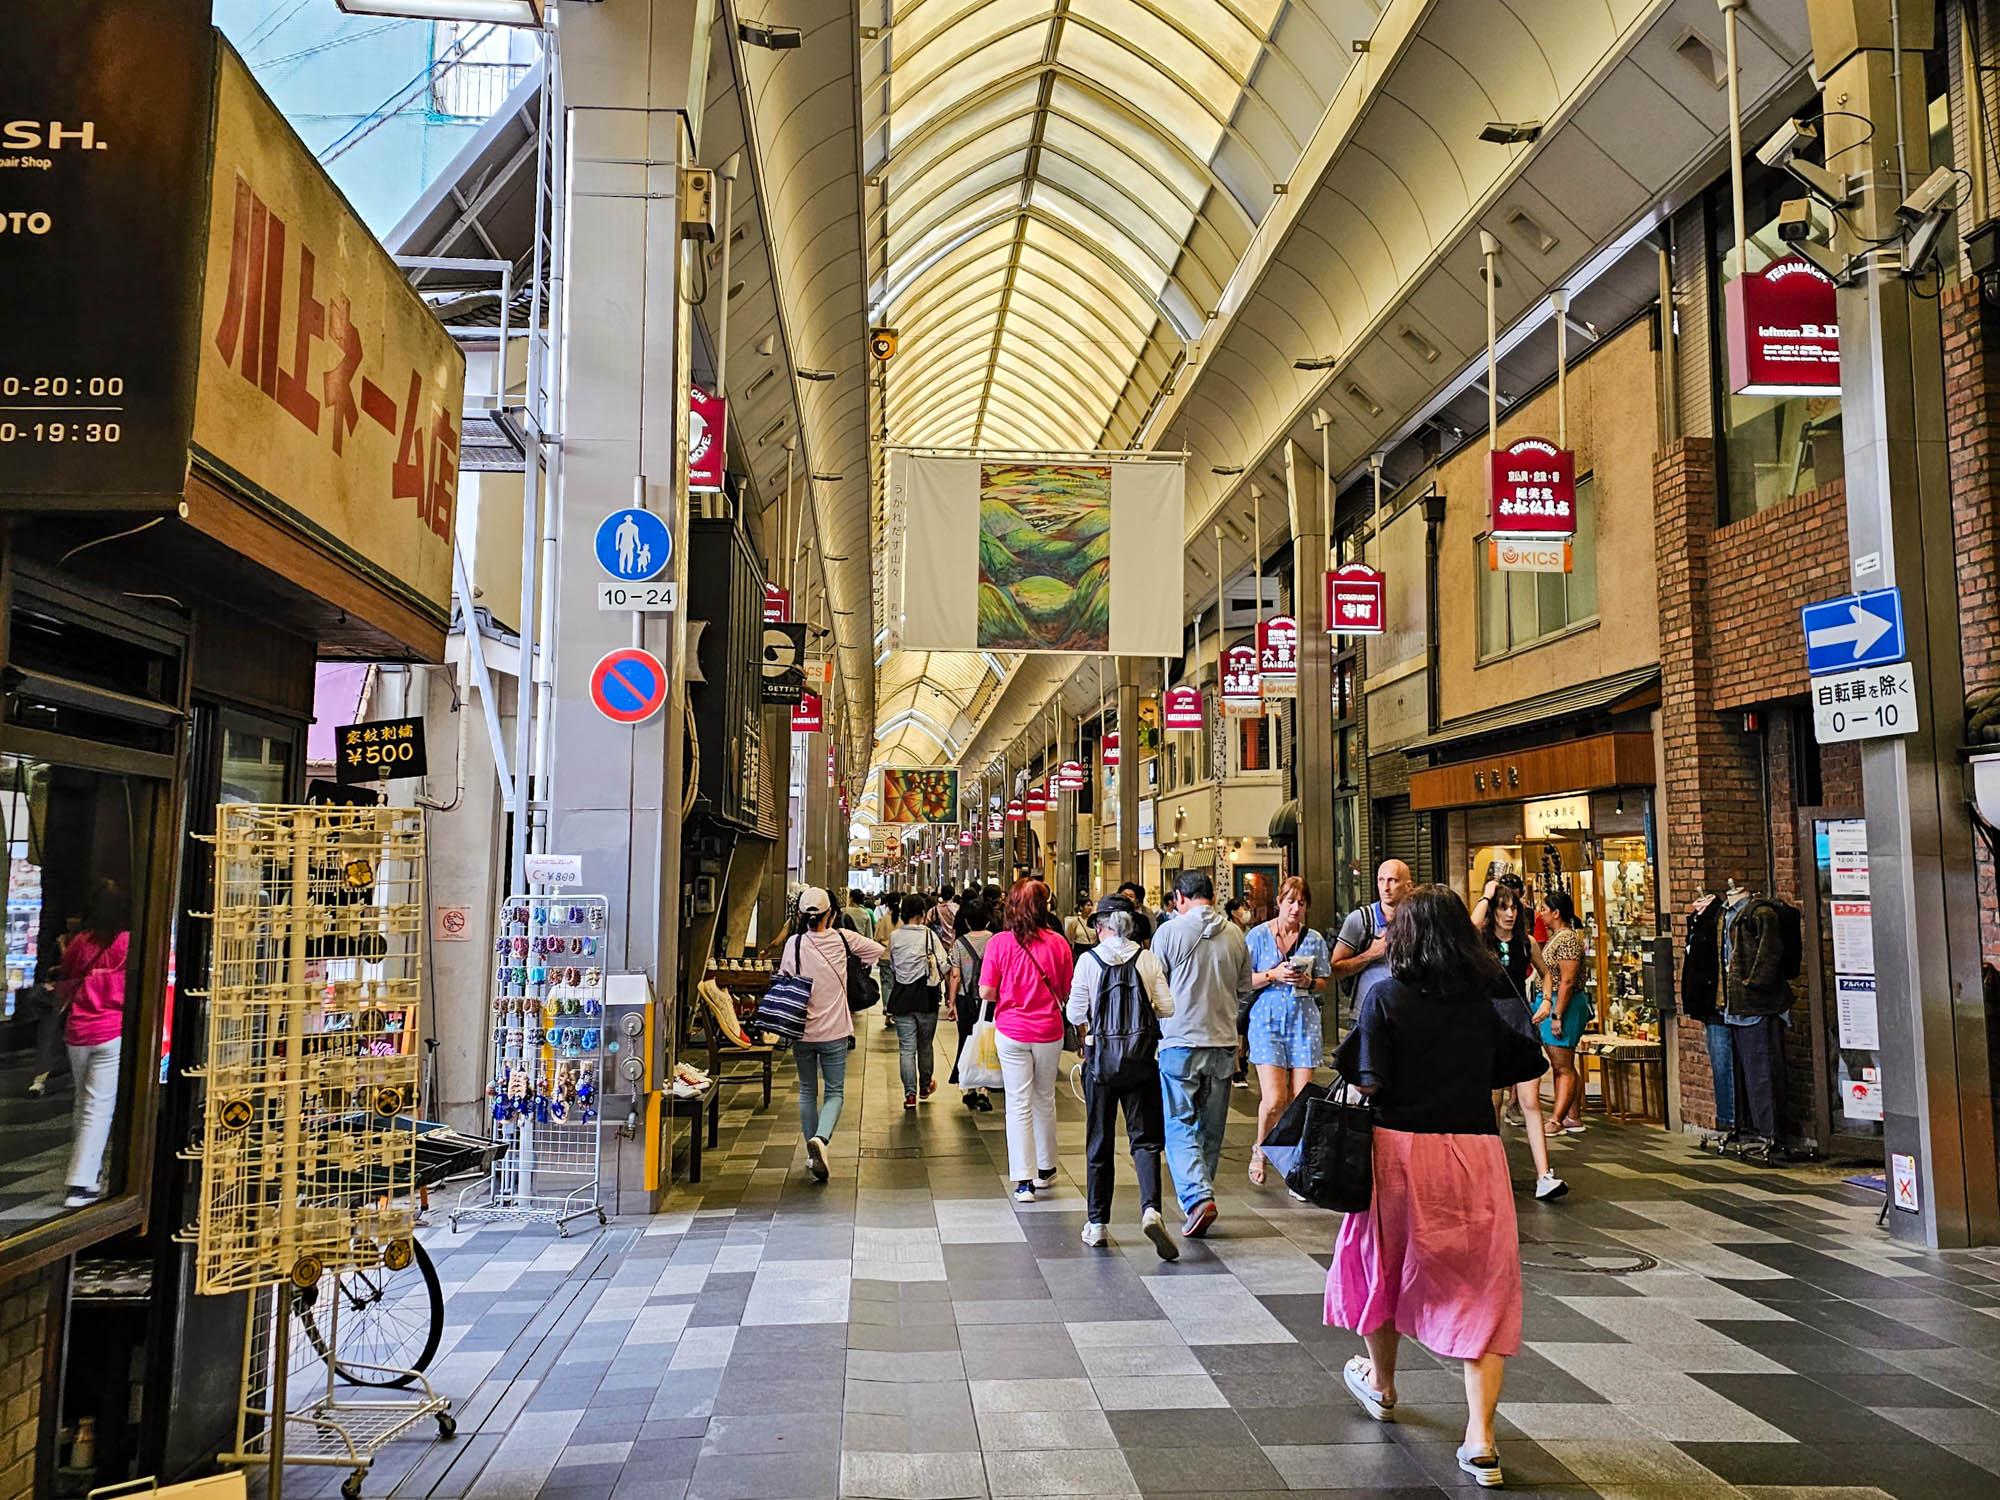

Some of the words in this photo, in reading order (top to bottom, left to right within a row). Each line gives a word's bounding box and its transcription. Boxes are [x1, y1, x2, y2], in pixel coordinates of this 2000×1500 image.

[20, 156, 52, 170] Shop
[0, 211, 52, 235] TO
[1758, 326, 1800, 338] loftman
[215, 173, 459, 545] 川上ネーム店
[1509, 441, 1557, 457] TERAMACHI
[1521, 551, 1559, 566] KICS
[1342, 603, 1372, 619] 寺町
[1818, 676, 1909, 706] 自転車を除く
[346, 723, 413, 746] 家紋刺繍
[346, 743, 413, 766] ¥500
